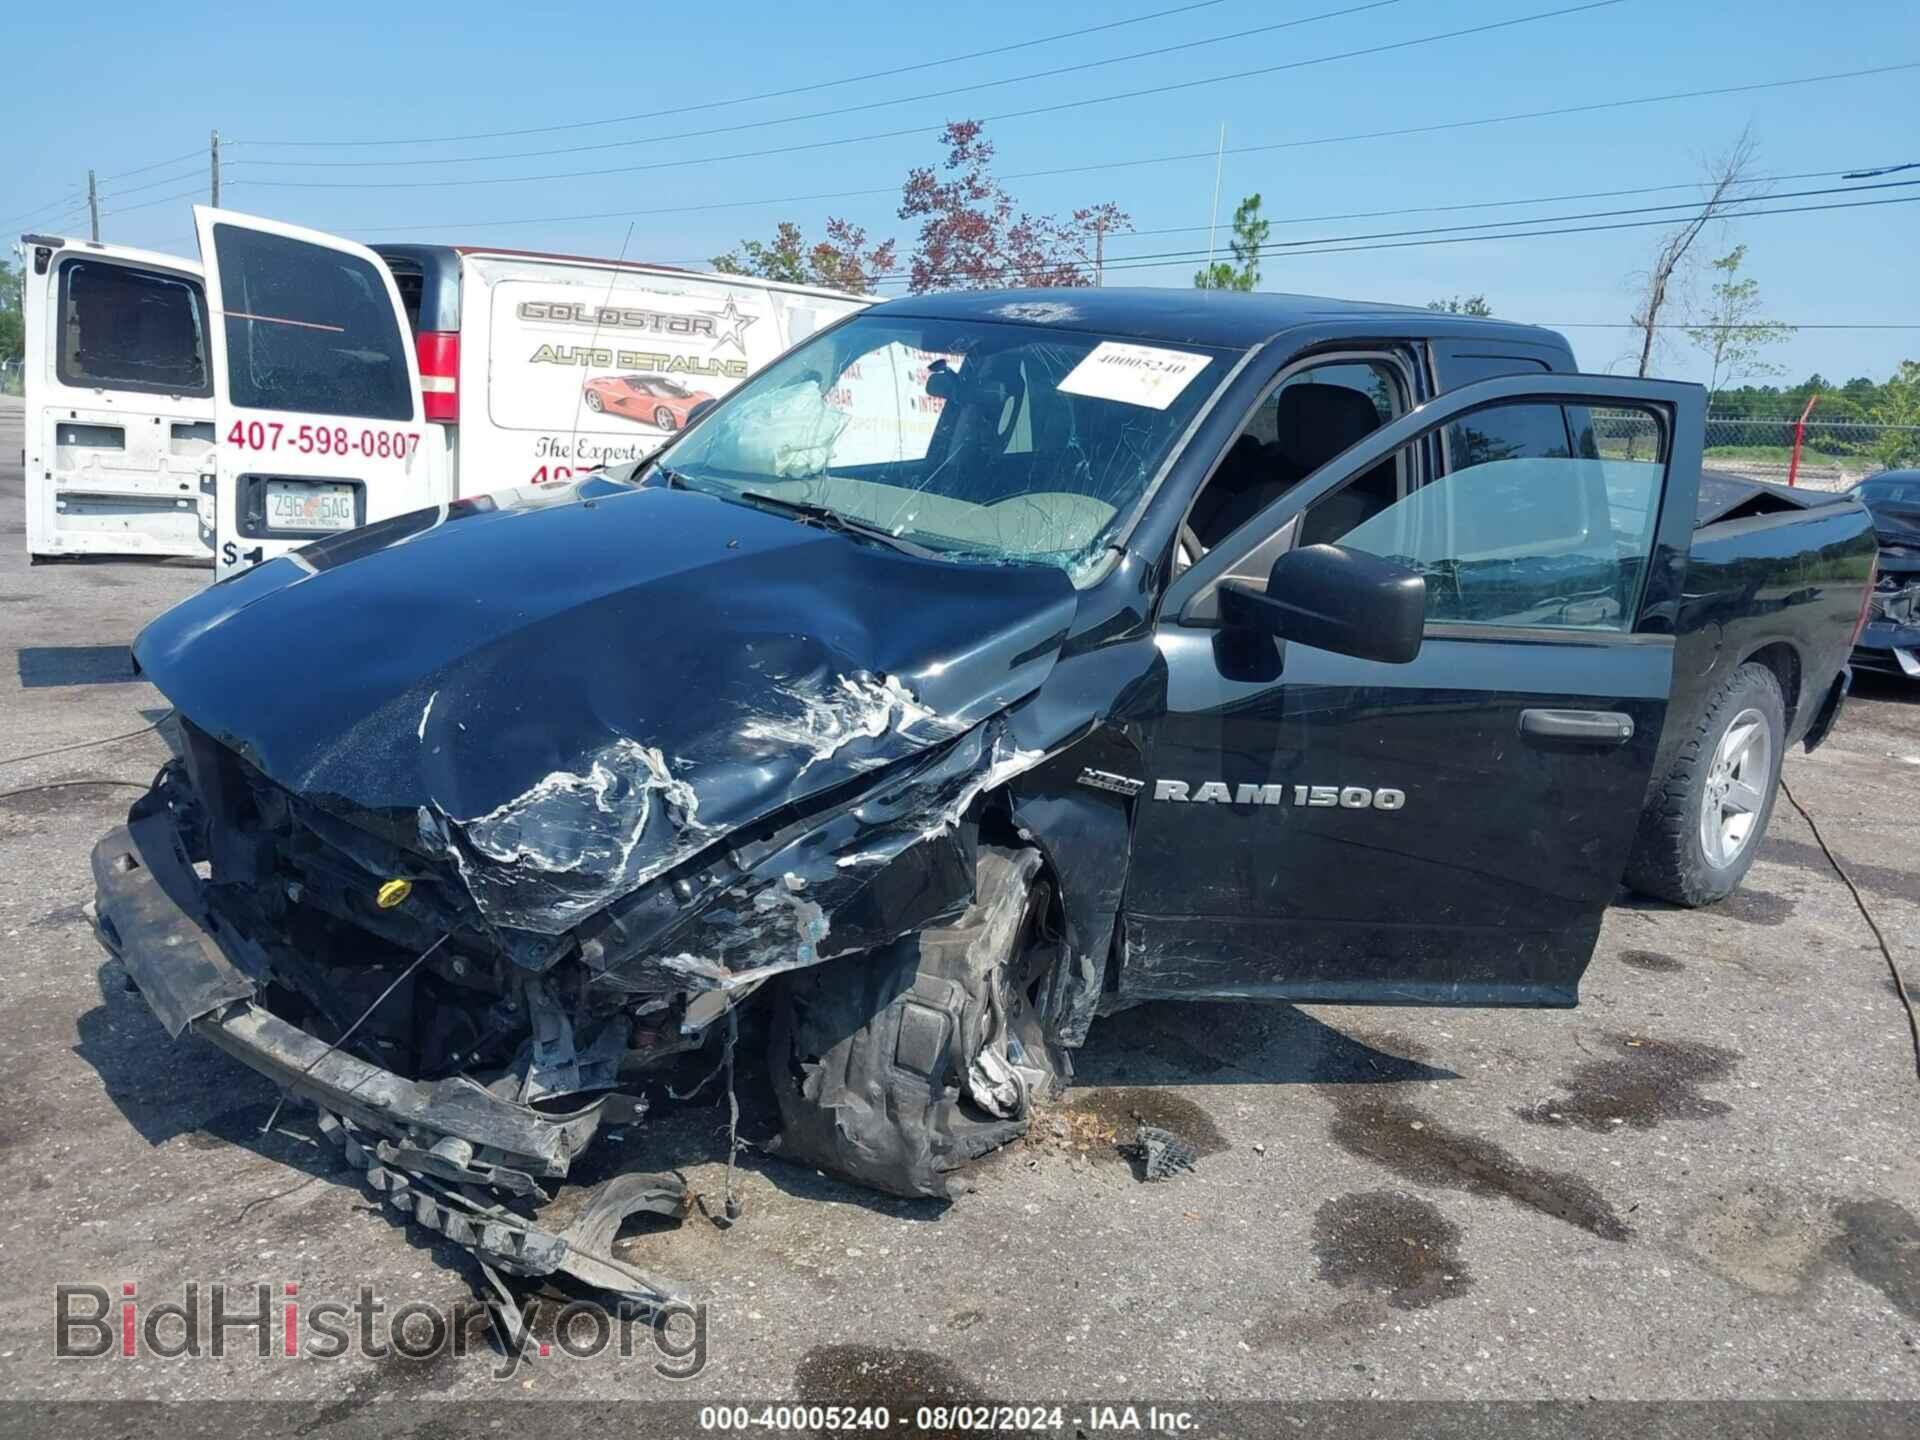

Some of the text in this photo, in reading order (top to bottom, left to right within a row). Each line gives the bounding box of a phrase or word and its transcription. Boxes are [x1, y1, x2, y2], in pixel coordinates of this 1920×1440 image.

[529, 344, 748, 378] AUTO DETAILING
[227, 420, 420, 459] 407-598-0807
[535, 436, 646, 465] The Experts
[1153, 779, 1283, 806] RAM
[1293, 784, 1406, 811] 1500
